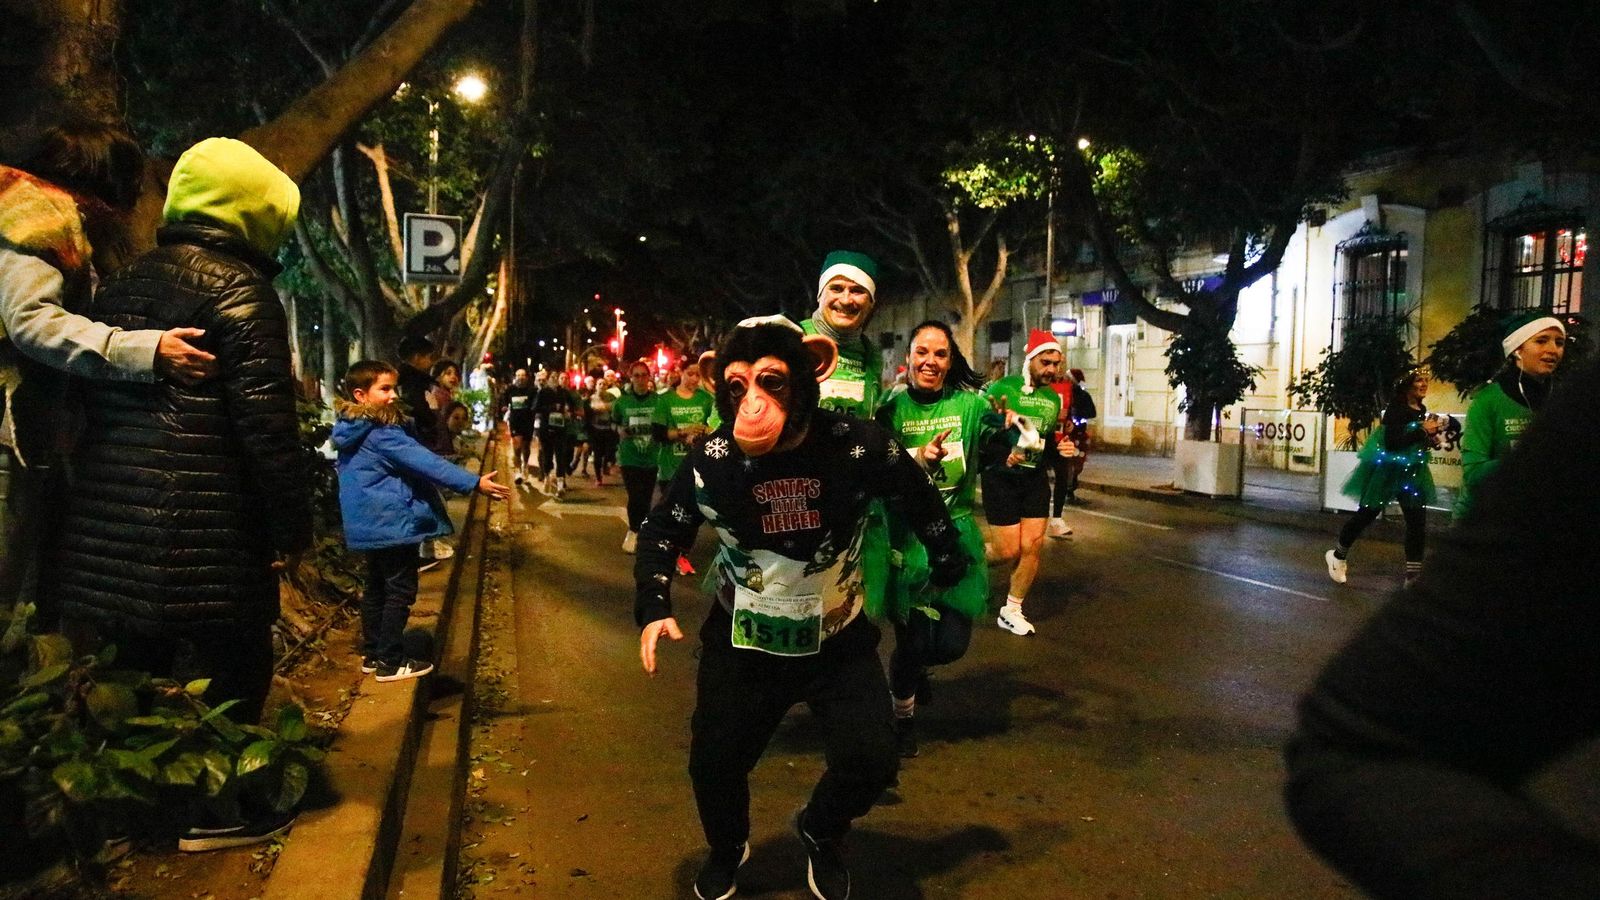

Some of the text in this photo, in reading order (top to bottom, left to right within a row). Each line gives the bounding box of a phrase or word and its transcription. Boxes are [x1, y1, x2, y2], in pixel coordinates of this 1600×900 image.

[411, 219, 456, 272] P
[902, 425, 925, 433] CIUDAD
[926, 424, 936, 432] DE
[930, 415, 961, 425] SILVESTRE
[1256, 421, 1306, 442] ROSSO
[752, 477, 820, 504] SANTA'S
[770, 496, 807, 513] LITTLE
[762, 509, 820, 534] HELPER
[740, 617, 813, 648] 1518
